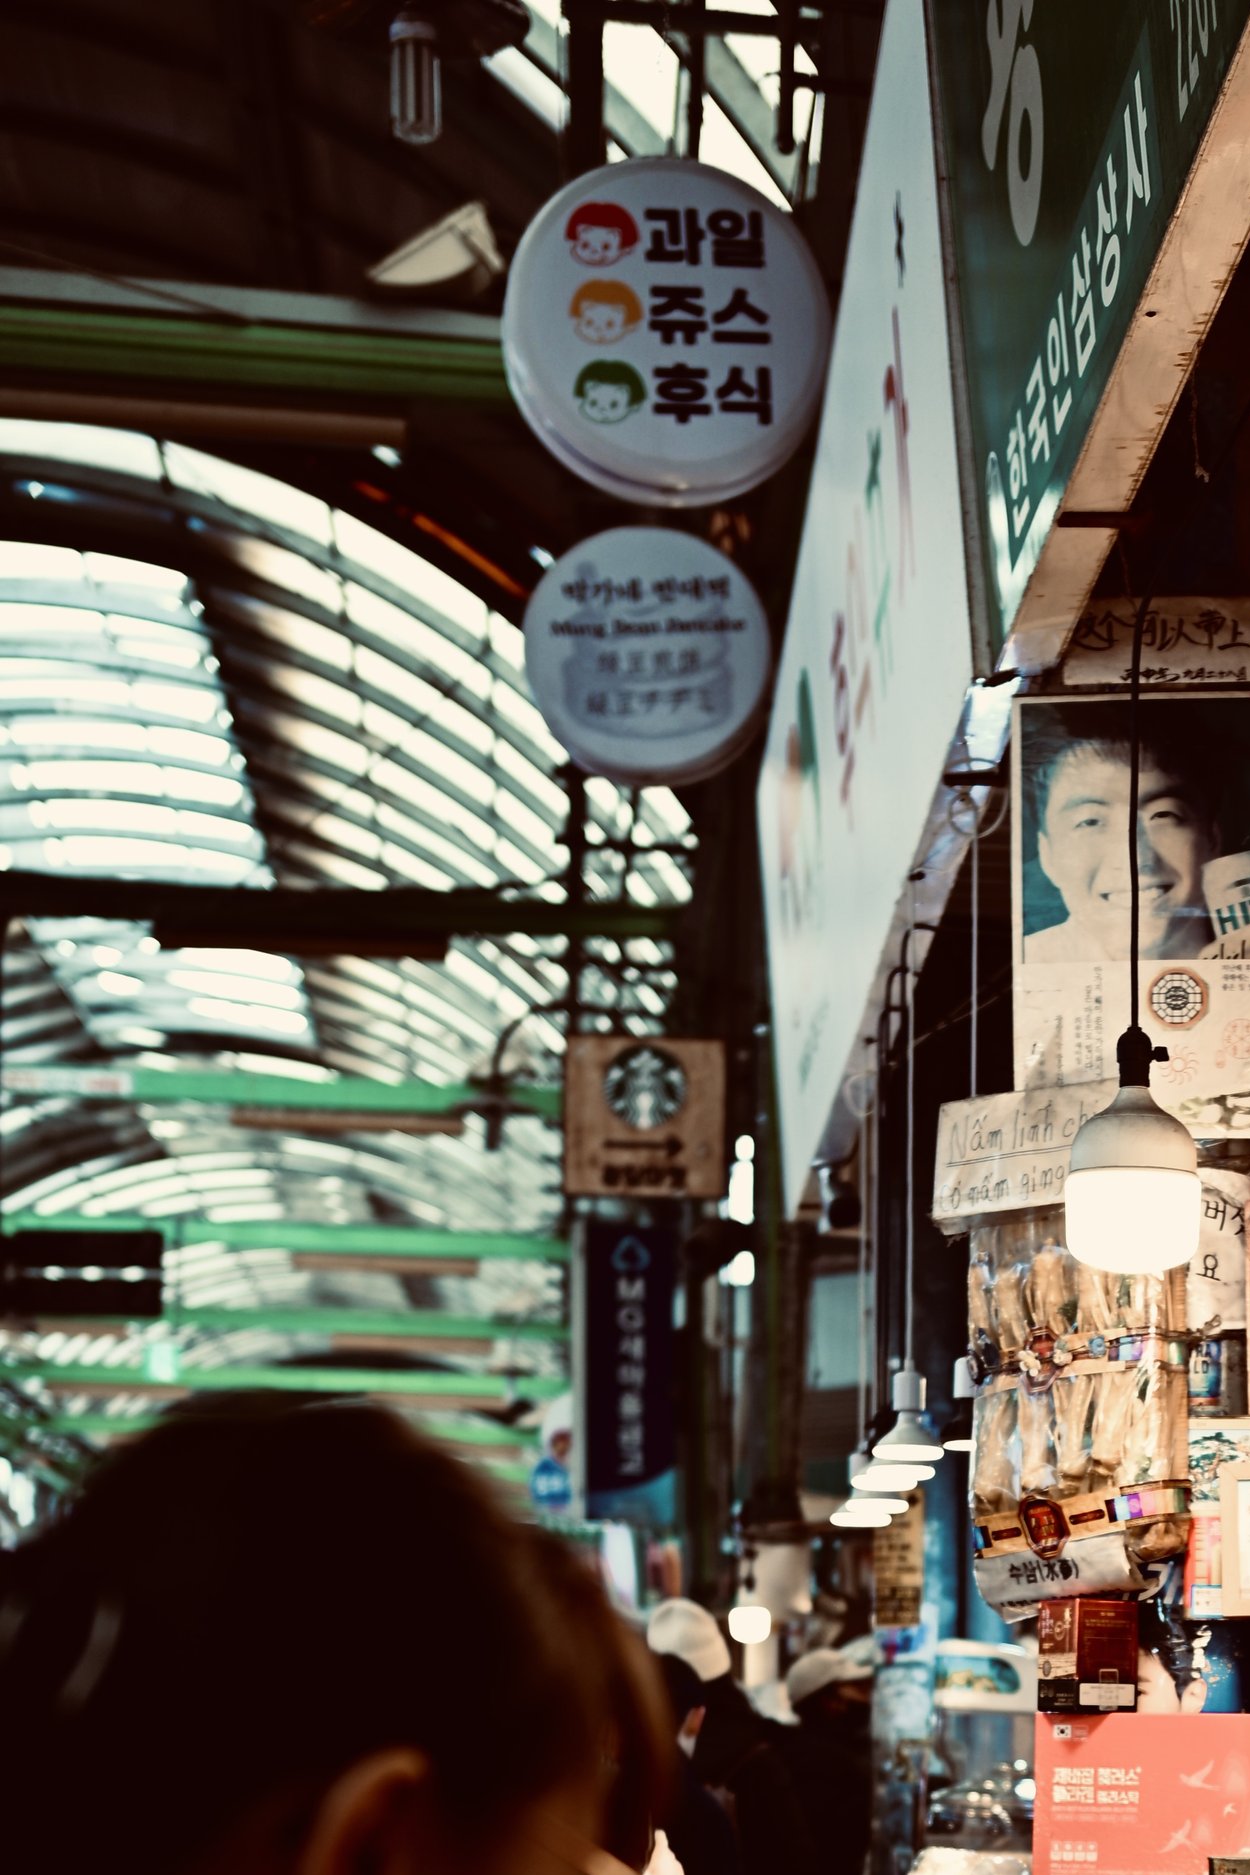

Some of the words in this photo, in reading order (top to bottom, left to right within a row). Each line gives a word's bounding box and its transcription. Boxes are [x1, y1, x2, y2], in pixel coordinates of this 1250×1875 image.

[644, 207, 767, 270] 과일
[648, 283, 772, 348] 쥬스
[1005, 70, 1151, 541] 한국인삼상사
[652, 364, 774, 425] 후식
